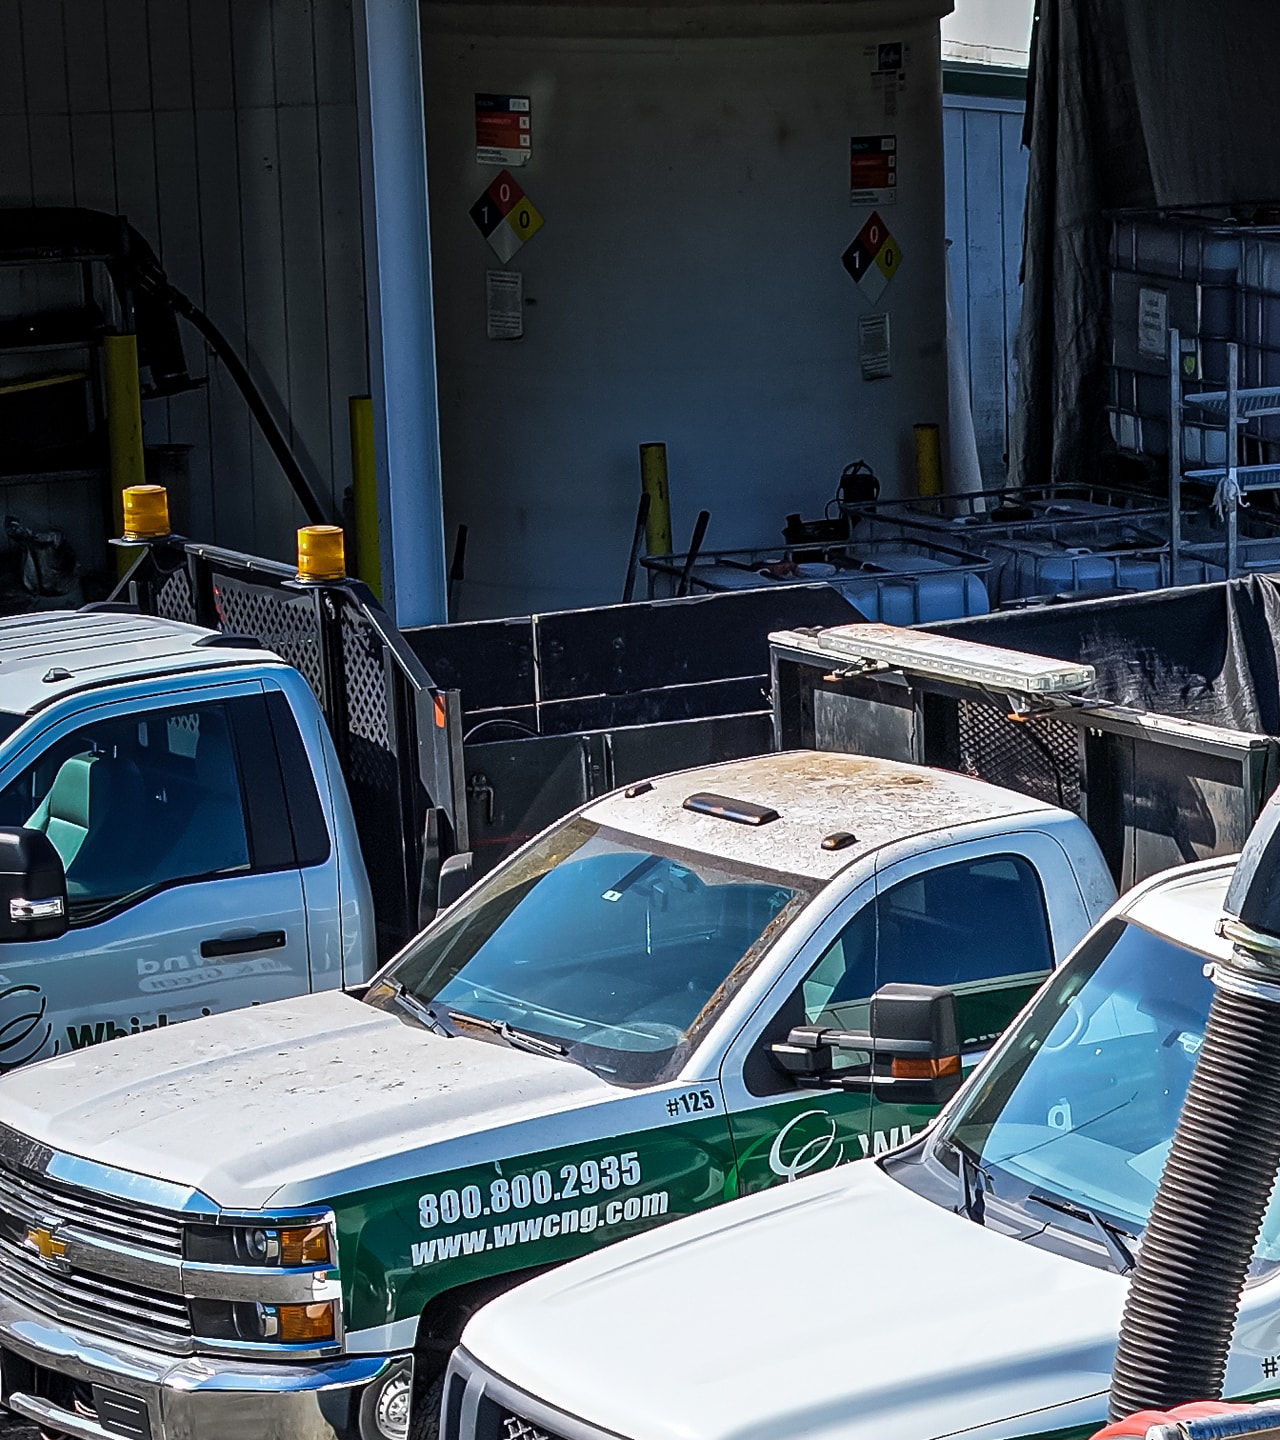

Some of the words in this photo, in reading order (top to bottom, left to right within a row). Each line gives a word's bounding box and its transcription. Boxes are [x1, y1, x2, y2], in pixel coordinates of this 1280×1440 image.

[499, 183, 510, 202] 0
[519, 209, 530, 229] 0
[869, 224, 879, 243] 0
[884, 248, 893, 267] 0
[666, 1089, 715, 1117] #125
[418, 1151, 641, 1229] 800.800.2935
[411, 1191, 669, 1267] www.wwcng.com
